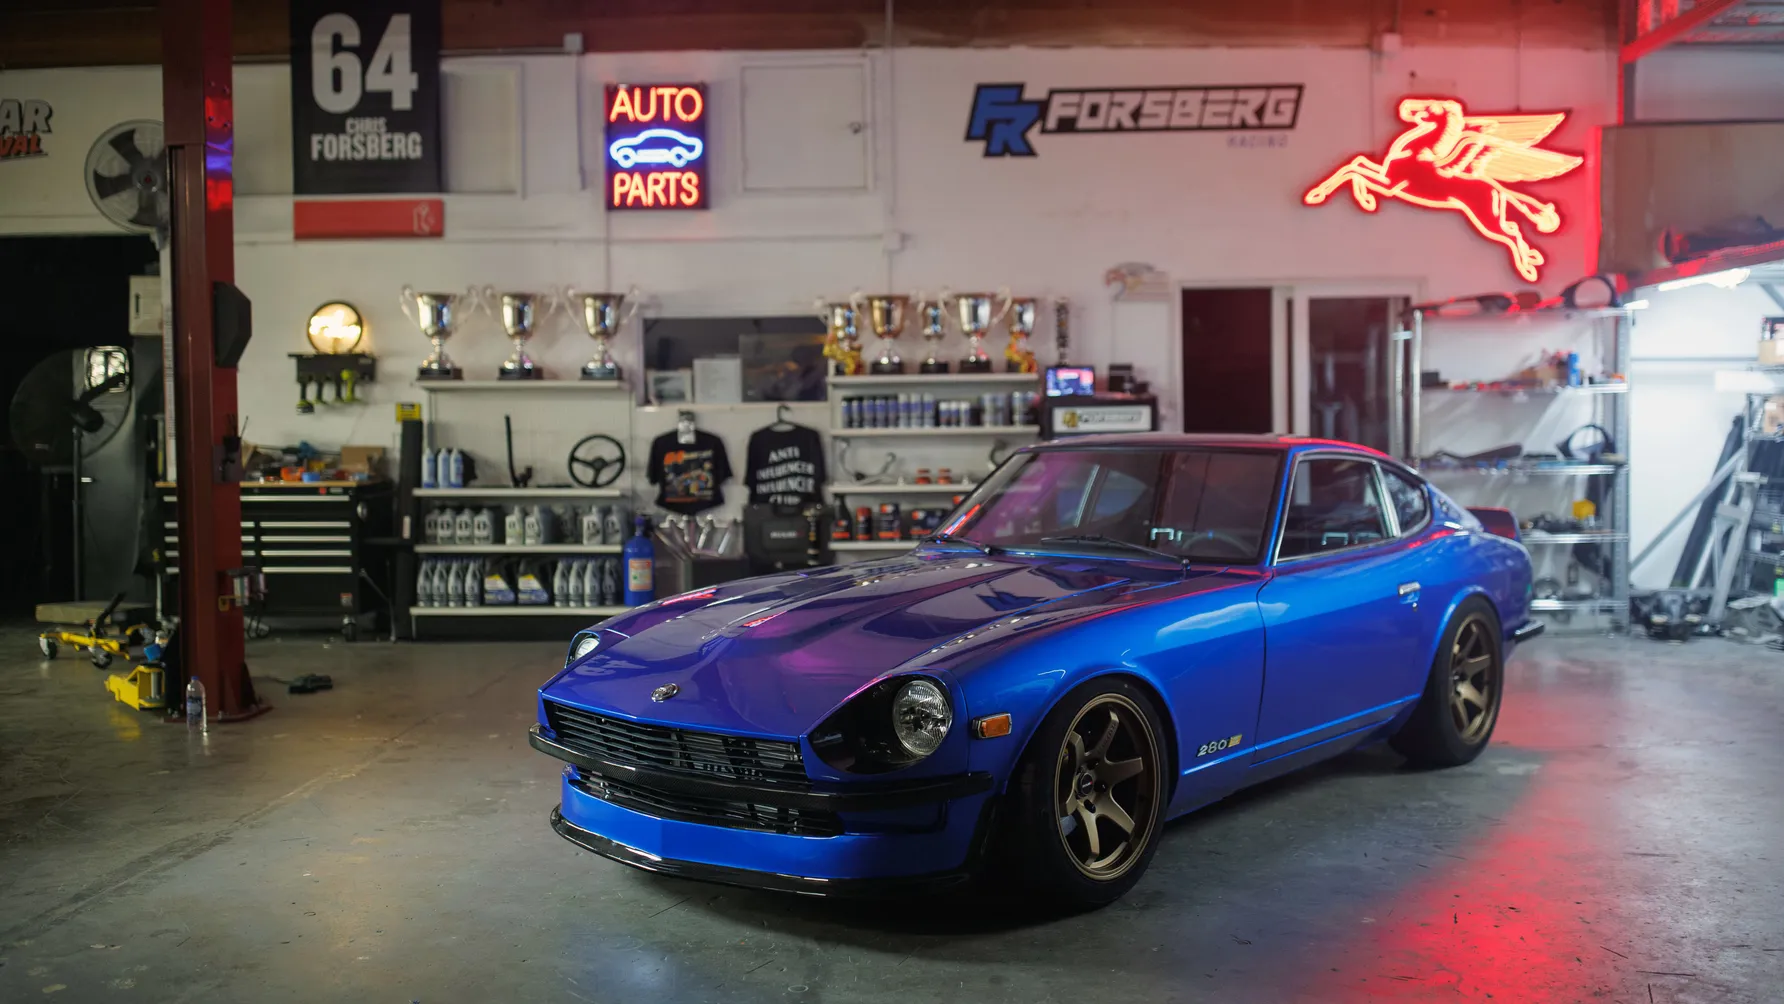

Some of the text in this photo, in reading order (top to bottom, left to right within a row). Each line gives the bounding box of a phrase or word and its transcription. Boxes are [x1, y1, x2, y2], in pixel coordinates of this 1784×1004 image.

[310, 12, 418, 114] 64
[609, 86, 704, 122] AUTO
[1041, 86, 1303, 133] FORSBERG
[345, 116, 388, 134] CHRIS
[310, 132, 422, 161] FORSBERG
[613, 171, 699, 206] PARTS
[768, 446, 801, 464] ANTI
